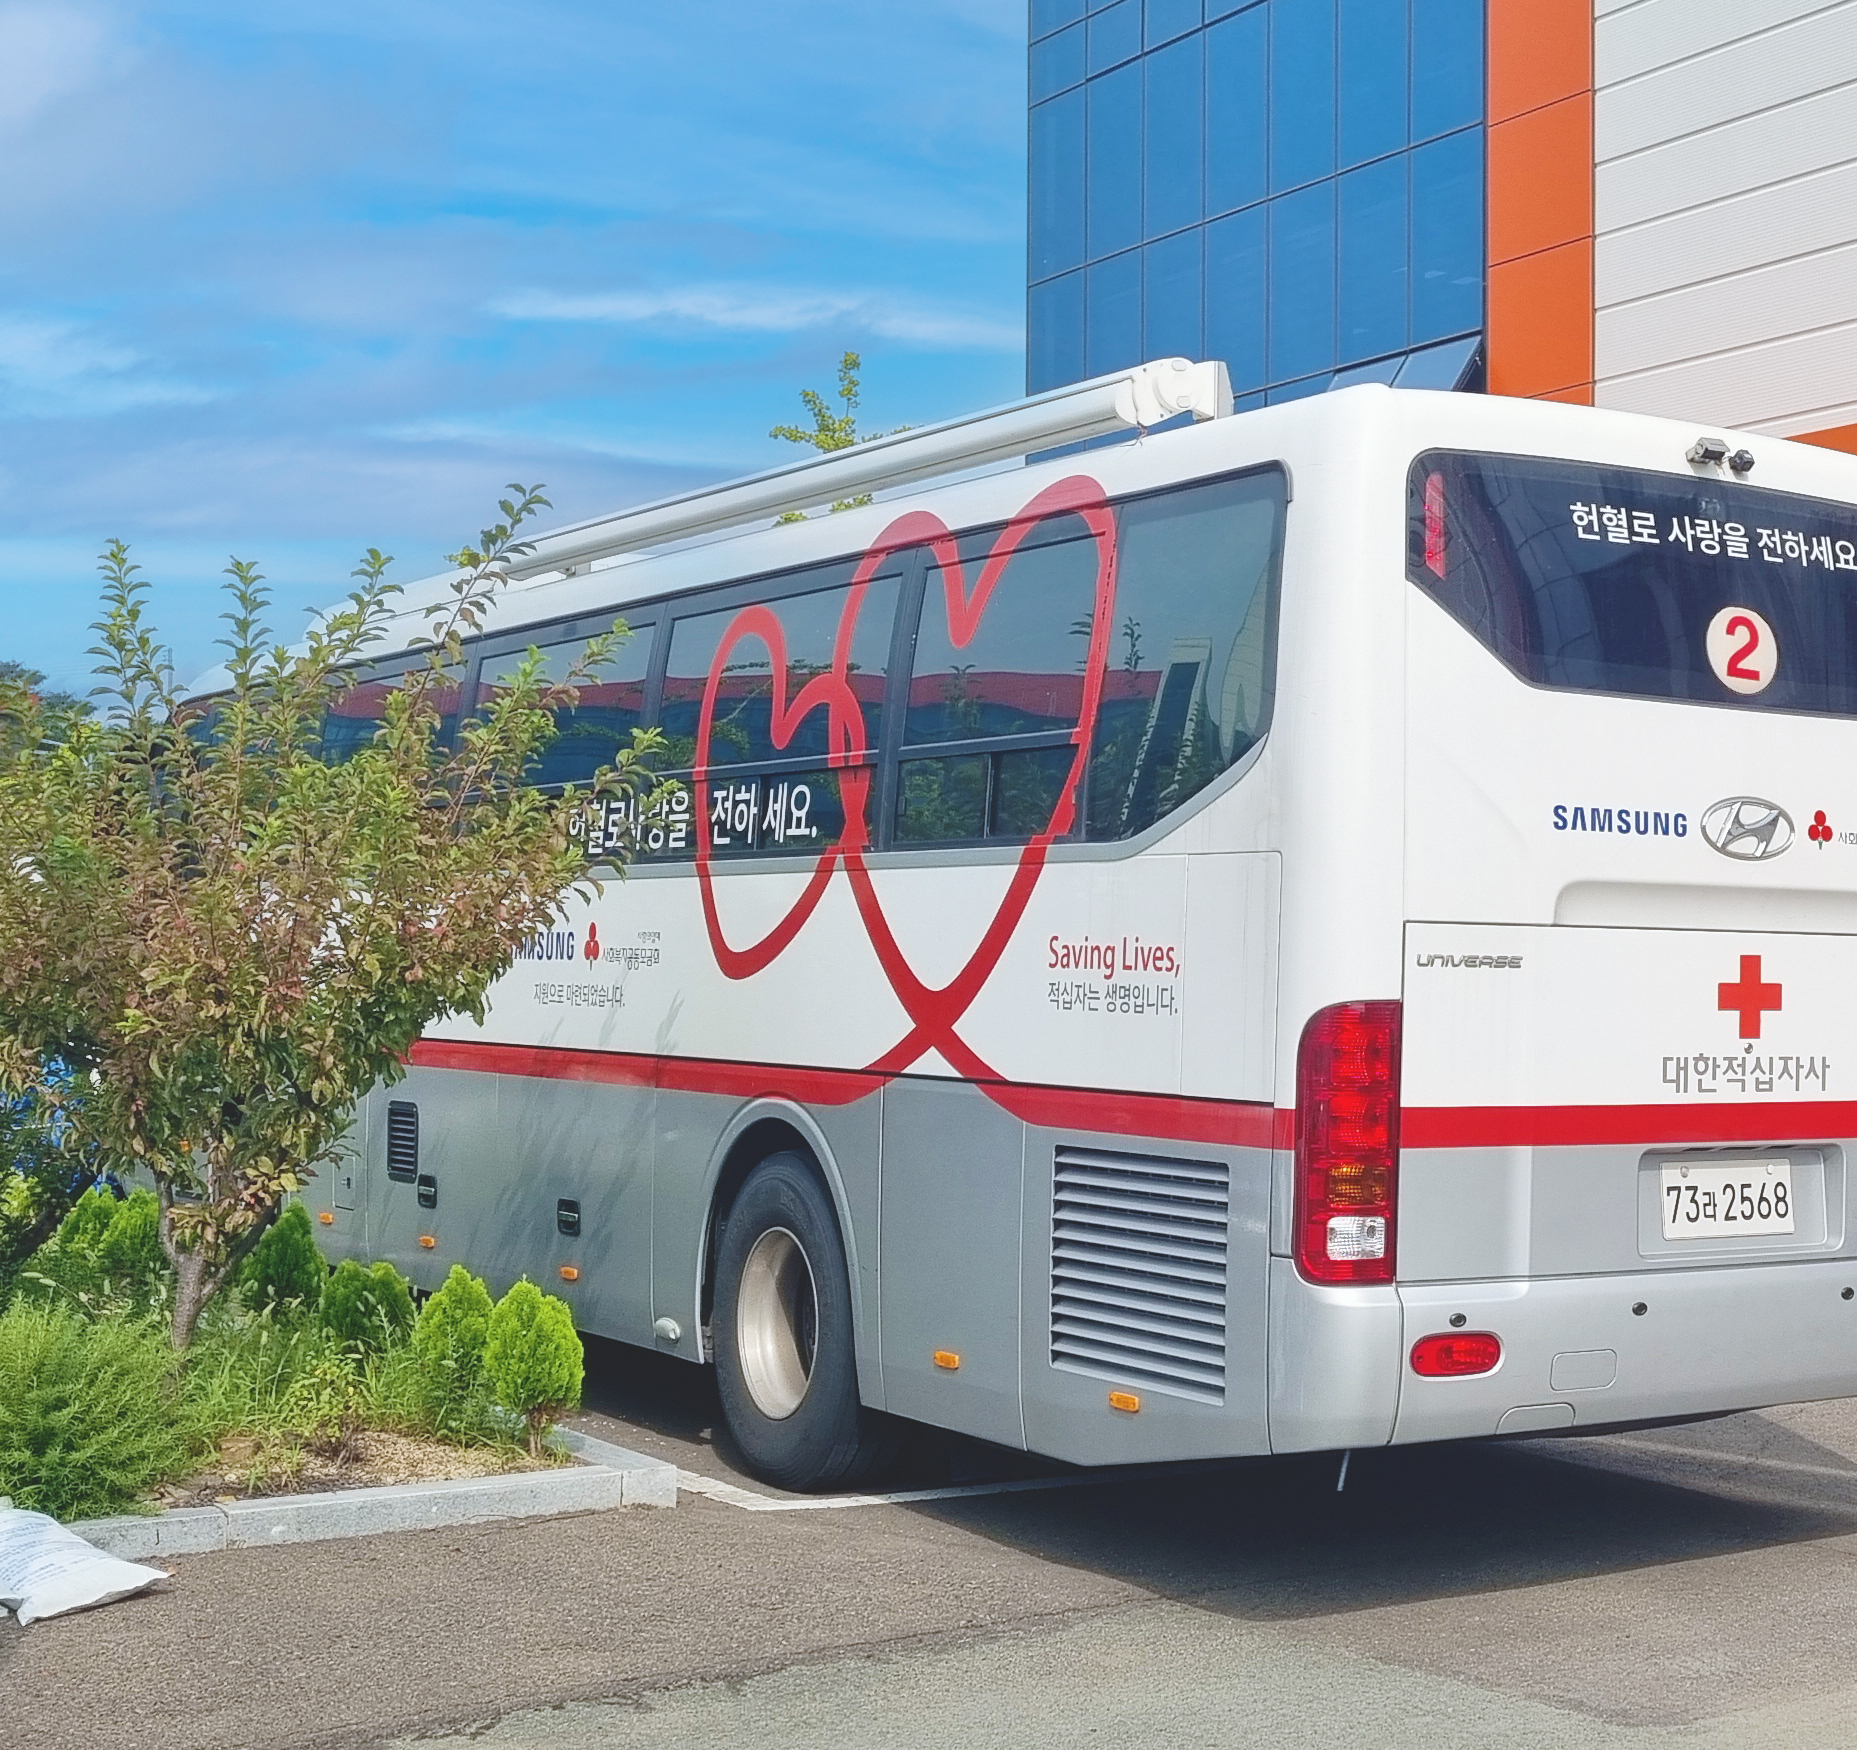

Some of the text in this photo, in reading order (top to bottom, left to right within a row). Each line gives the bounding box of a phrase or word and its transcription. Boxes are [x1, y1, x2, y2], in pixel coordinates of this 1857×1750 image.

[1569, 501, 1660, 544] 헌혈로
[1668, 515, 1749, 559] 사랑을
[1725, 615, 1761, 681] 2
[1553, 804, 1688, 838] SAMSUNG
[1048, 935, 1180, 980] Saving Lives,
[1416, 953, 1523, 969] UNIVERSE
[534, 981, 626, 1008] 지원으로 마련되었습니다.
[1048, 981, 1178, 1016] 적십자는 생명입니다.
[1662, 1052, 1831, 1094] 대한적십자사
